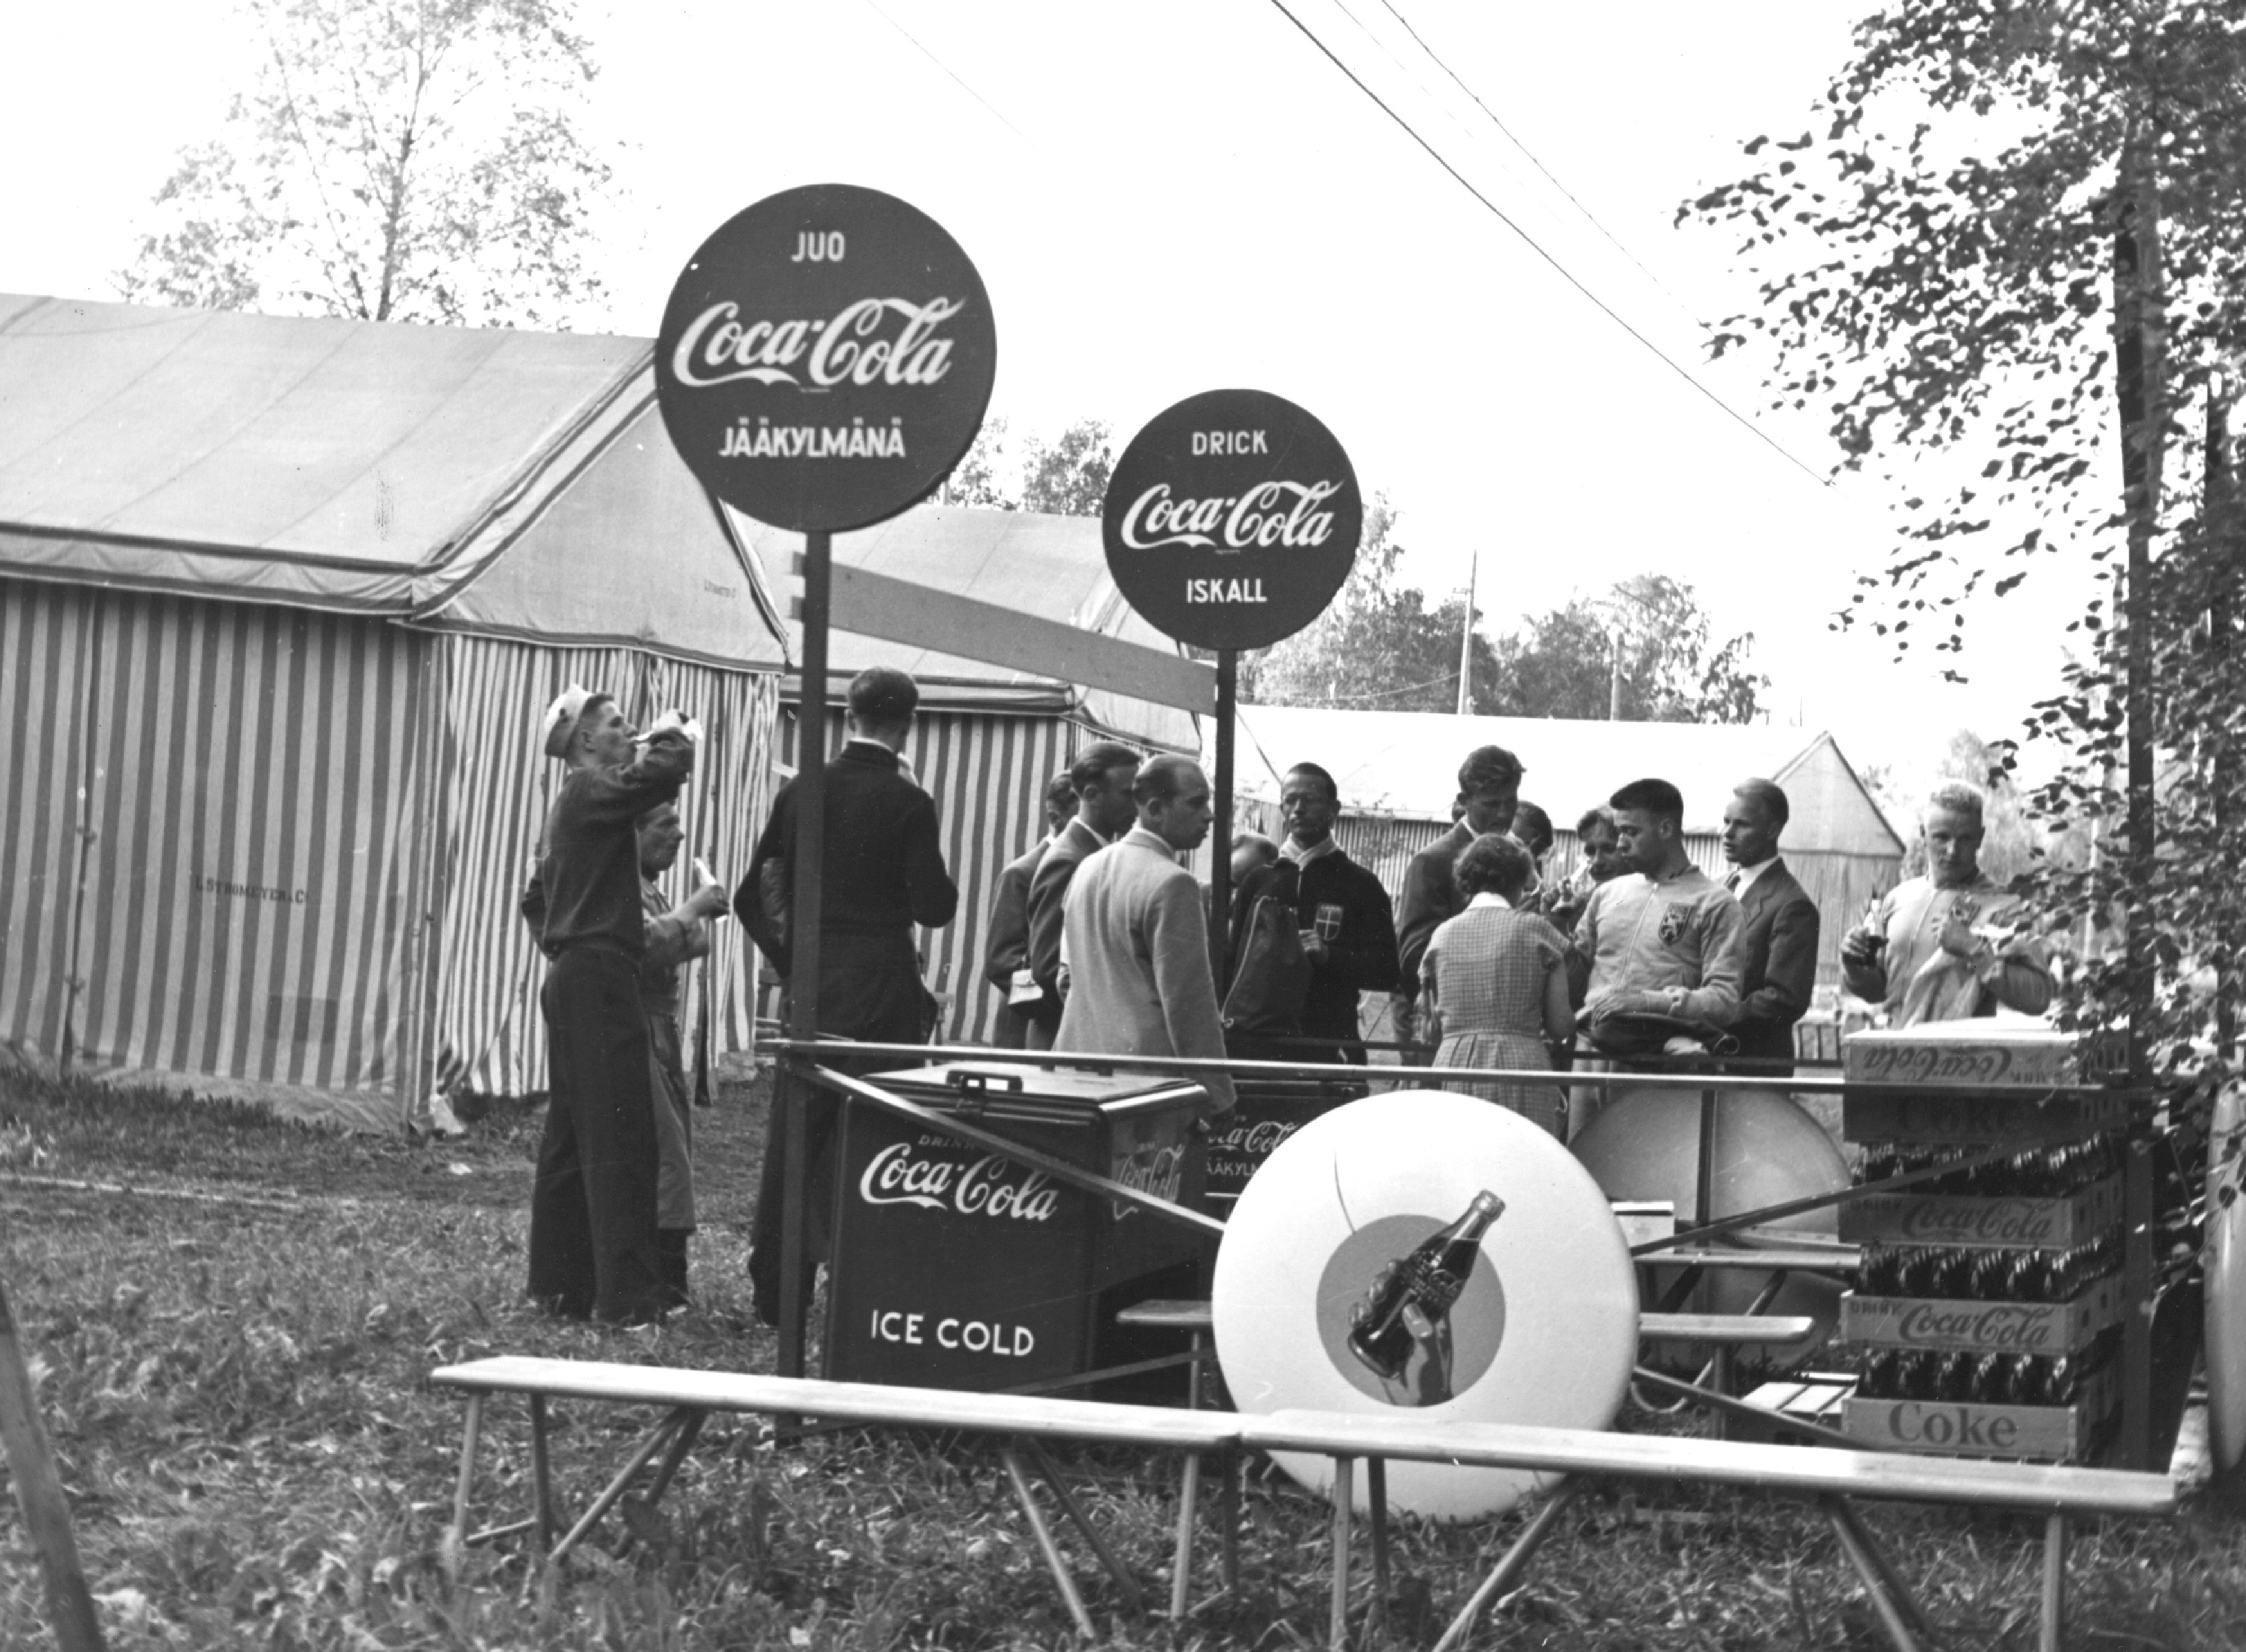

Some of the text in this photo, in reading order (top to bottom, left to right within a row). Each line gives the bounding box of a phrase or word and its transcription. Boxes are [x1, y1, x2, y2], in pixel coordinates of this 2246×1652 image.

[790, 231, 846, 262] JUO
[672, 297, 968, 388] Coca-Cola
[719, 416, 906, 457] JÄÄKYLMÄNÄ
[1192, 430, 1268, 456] DRICK
[1121, 480, 1345, 550] Coca-Cola
[1186, 578, 1267, 603] ISKALL
[859, 1142, 1059, 1222] Coca-Cola
[870, 1308, 1035, 1357] ICE COLD
[1899, 1303, 2056, 1345] Coca-Cola
[1888, 1402, 2018, 1449] Coke
